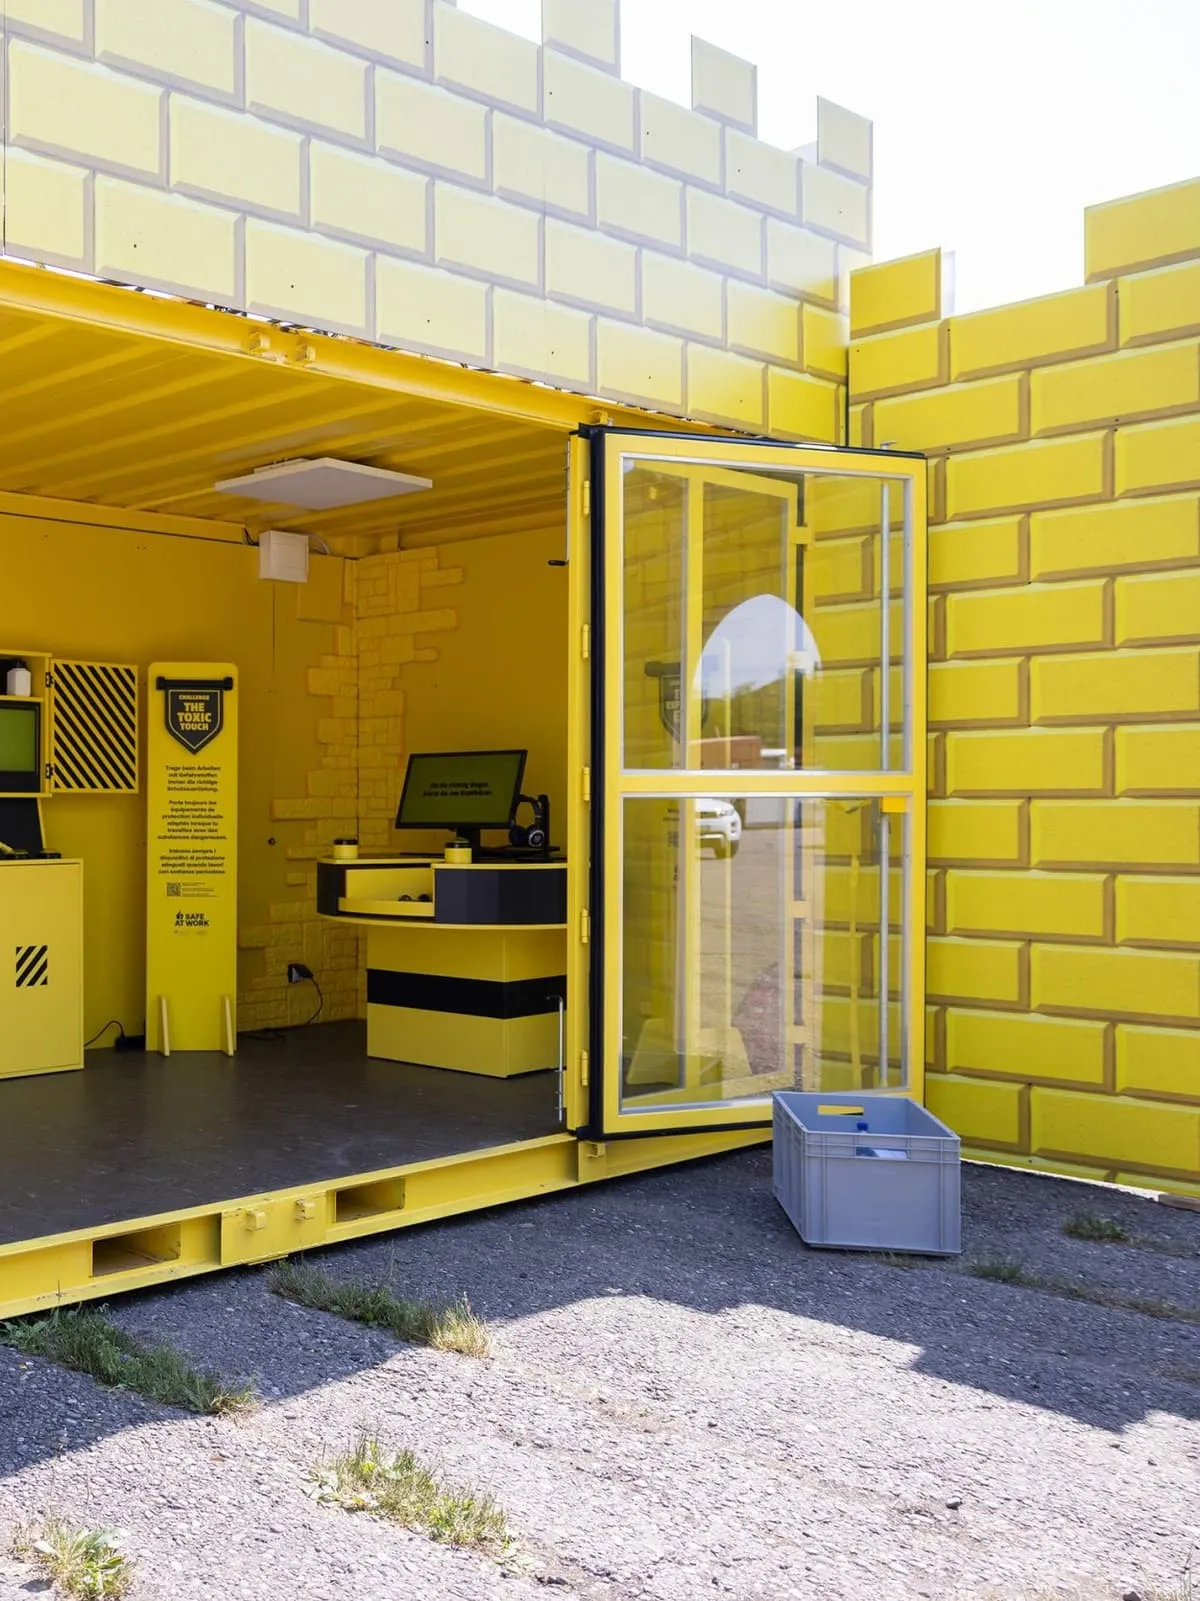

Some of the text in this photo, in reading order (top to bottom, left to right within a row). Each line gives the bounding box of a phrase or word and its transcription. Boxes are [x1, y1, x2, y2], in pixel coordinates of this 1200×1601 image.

[184, 702, 205, 712] THE
[177, 712, 212, 722] TOXIC
[180, 723, 209, 731] TOUCH
